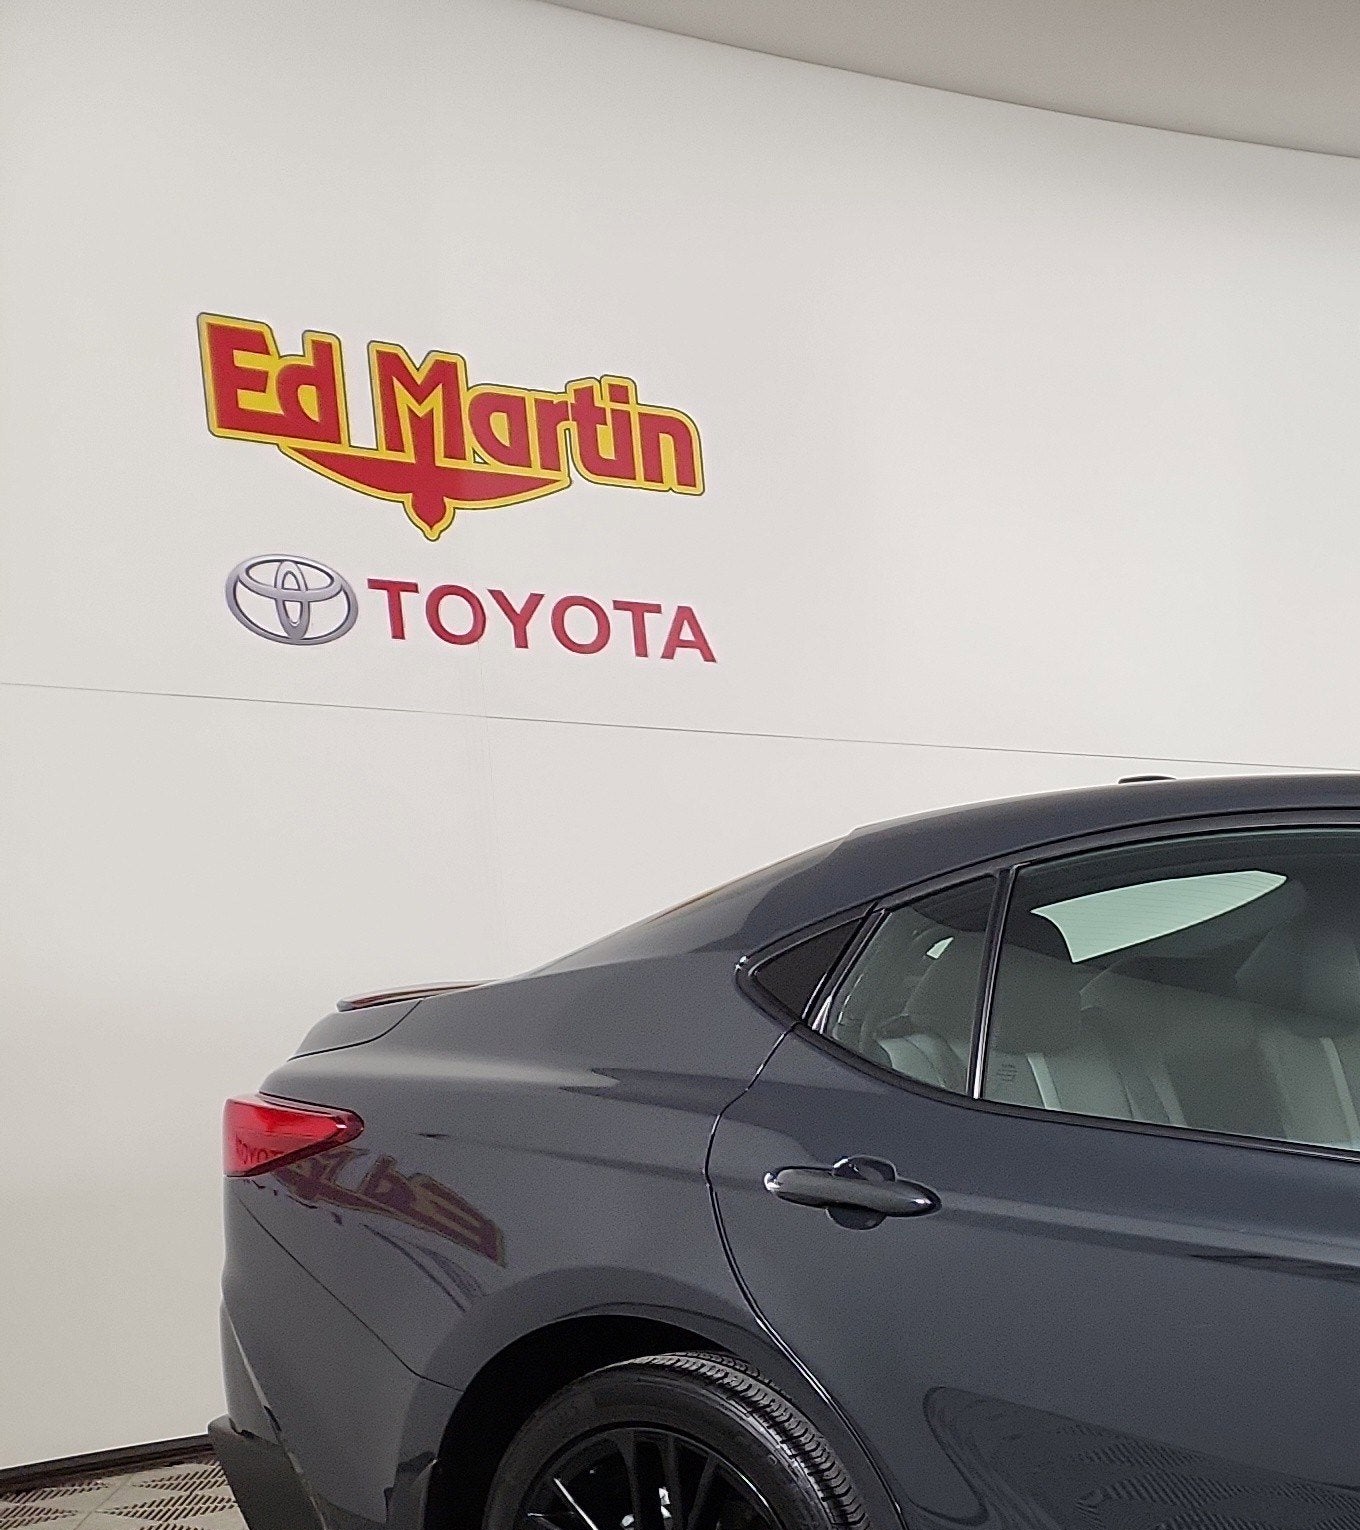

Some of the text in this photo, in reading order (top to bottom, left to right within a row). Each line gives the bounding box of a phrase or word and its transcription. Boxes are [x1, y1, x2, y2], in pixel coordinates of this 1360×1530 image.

[199, 313, 705, 497] Ed Martin
[367, 578, 718, 663] TOYOTA
